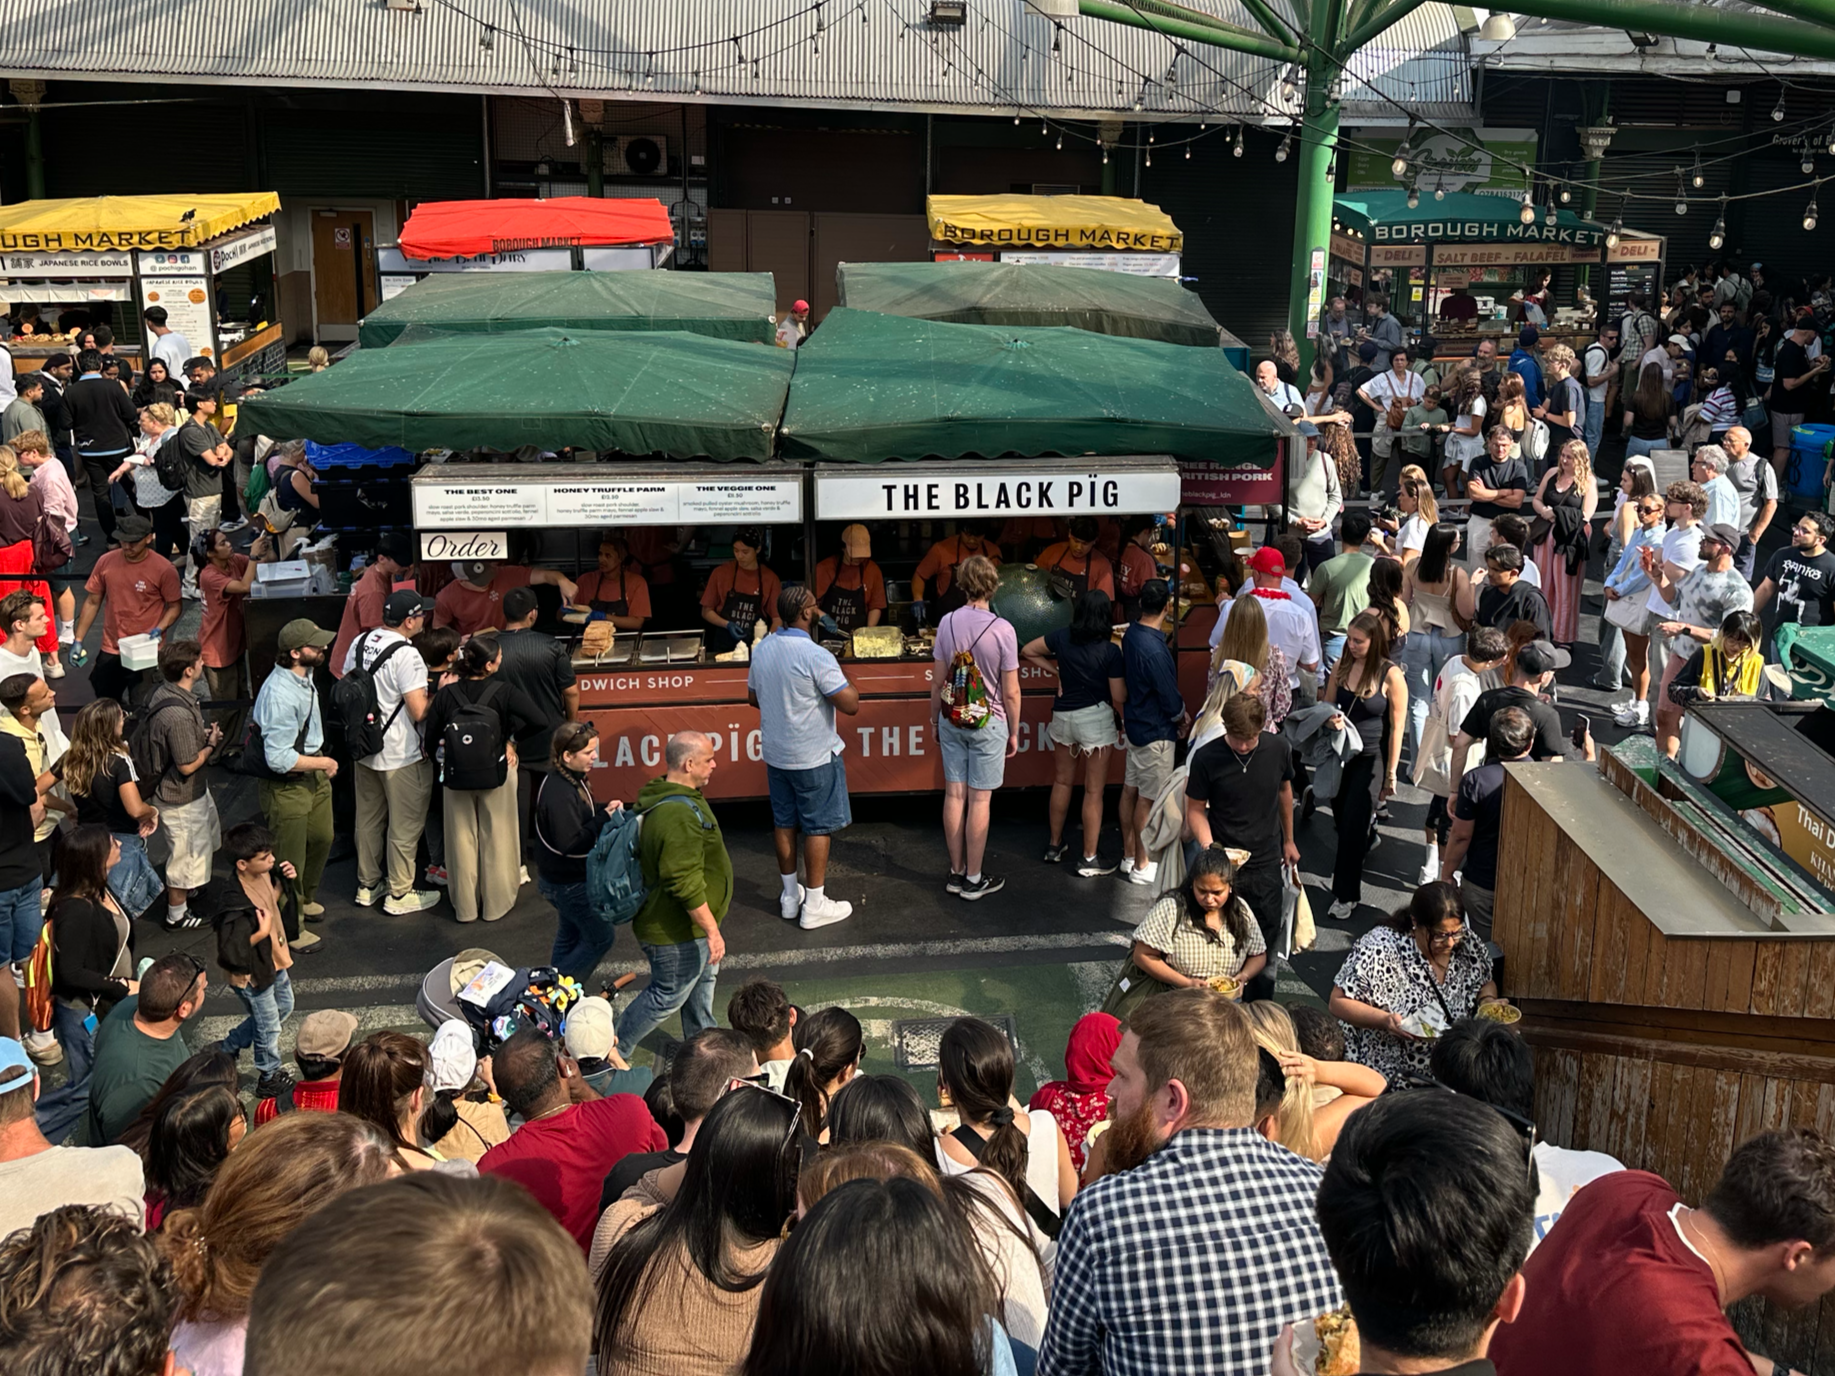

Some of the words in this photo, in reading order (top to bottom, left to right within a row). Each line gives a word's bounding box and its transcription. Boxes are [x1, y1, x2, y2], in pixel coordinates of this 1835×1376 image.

[74, 230, 191, 247] MARKET
[944, 225, 1069, 242] BOROUGH
[1080, 229, 1179, 249] MARKET
[1375, 223, 1498, 239] BOROUGH
[1507, 224, 1603, 245] MARKET
[492, 239, 539, 252] BOROUGH
[541, 237, 581, 249] MARKET
[1620, 246, 1648, 256] DELI
[39, 259, 79, 267] JAPANESE
[1384, 251, 1412, 261] DELI
[1437, 253, 1467, 263] SALT
[1470, 252, 1502, 262] BEEF
[1514, 252, 1566, 262] FALAFEL
[1182, 472, 1229, 481] RITISH
[1231, 472, 1273, 482] PORK
[882, 484, 940, 511] THE
[954, 482, 1054, 509] BLACK
[1068, 474, 1119, 508] PÏG
[427, 533, 501, 558] Order
[738, 601, 755, 612] THE
[838, 597, 853, 606] THE
[831, 604, 857, 615] BLACK
[1021, 667, 1054, 679] SHO
[581, 678, 640, 691] DWICH
[647, 676, 694, 689] SHOP
[857, 725, 925, 757] THE
[592, 734, 665, 768] LAC
[1797, 804, 1824, 840] Thai
